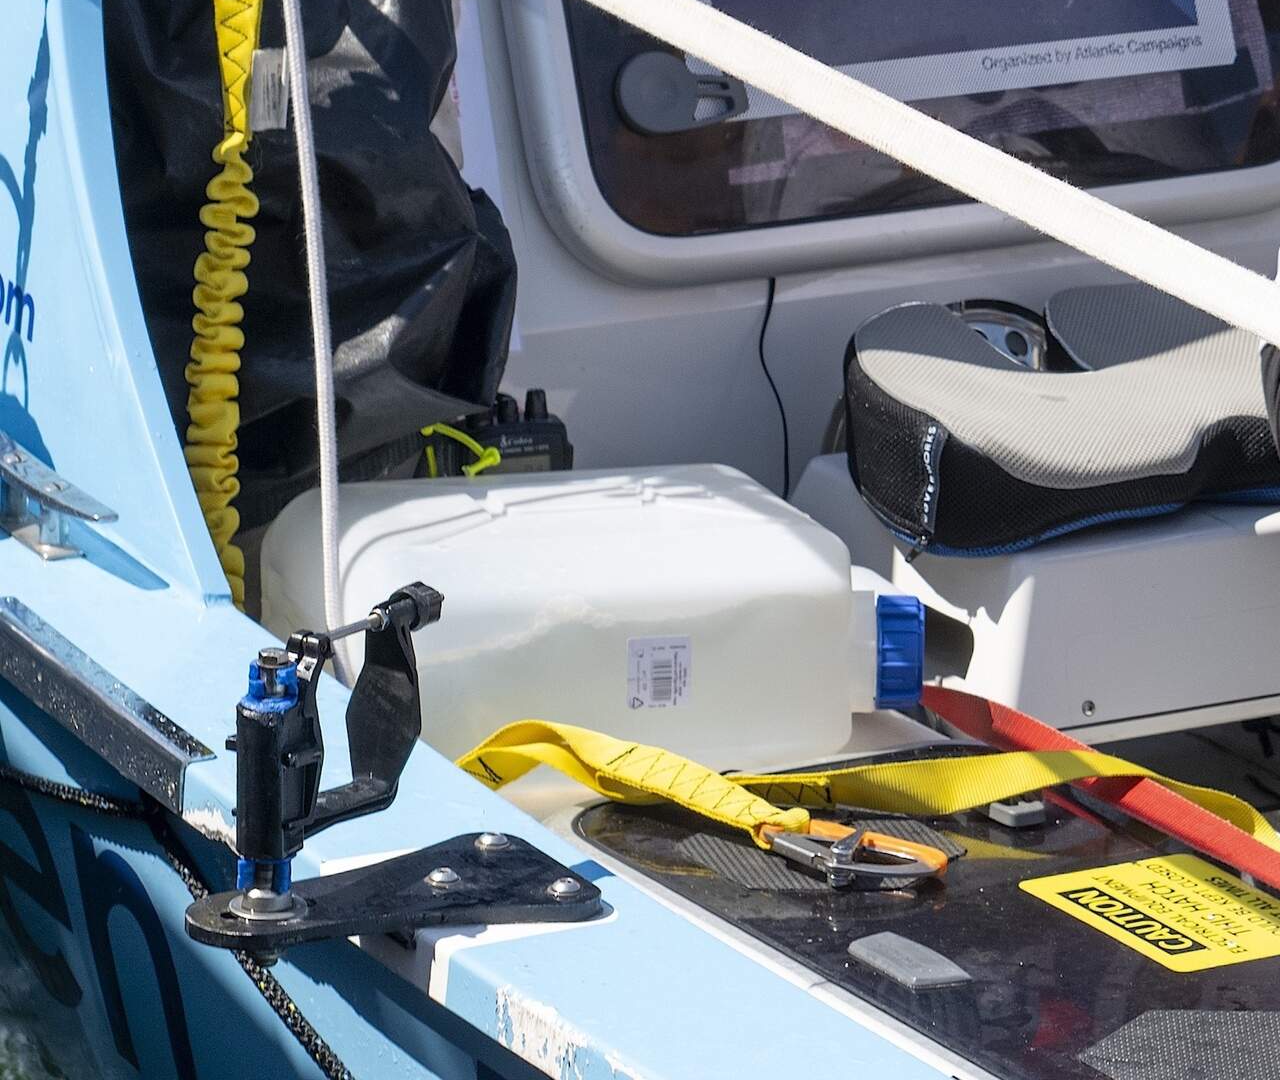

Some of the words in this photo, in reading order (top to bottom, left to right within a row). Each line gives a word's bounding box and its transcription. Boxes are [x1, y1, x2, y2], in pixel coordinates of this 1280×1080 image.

[982, 51, 1053, 72] Organized
[1055, 48, 1072, 64] by
[1074, 42, 1125, 60] Atlantic
[1127, 34, 1203, 54] Campaigns
[1137, 880, 1210, 913] HATCH
[1202, 876, 1253, 898] TIMES
[1065, 889, 1199, 951] CAUTION
[1197, 912, 1253, 935] THIS
